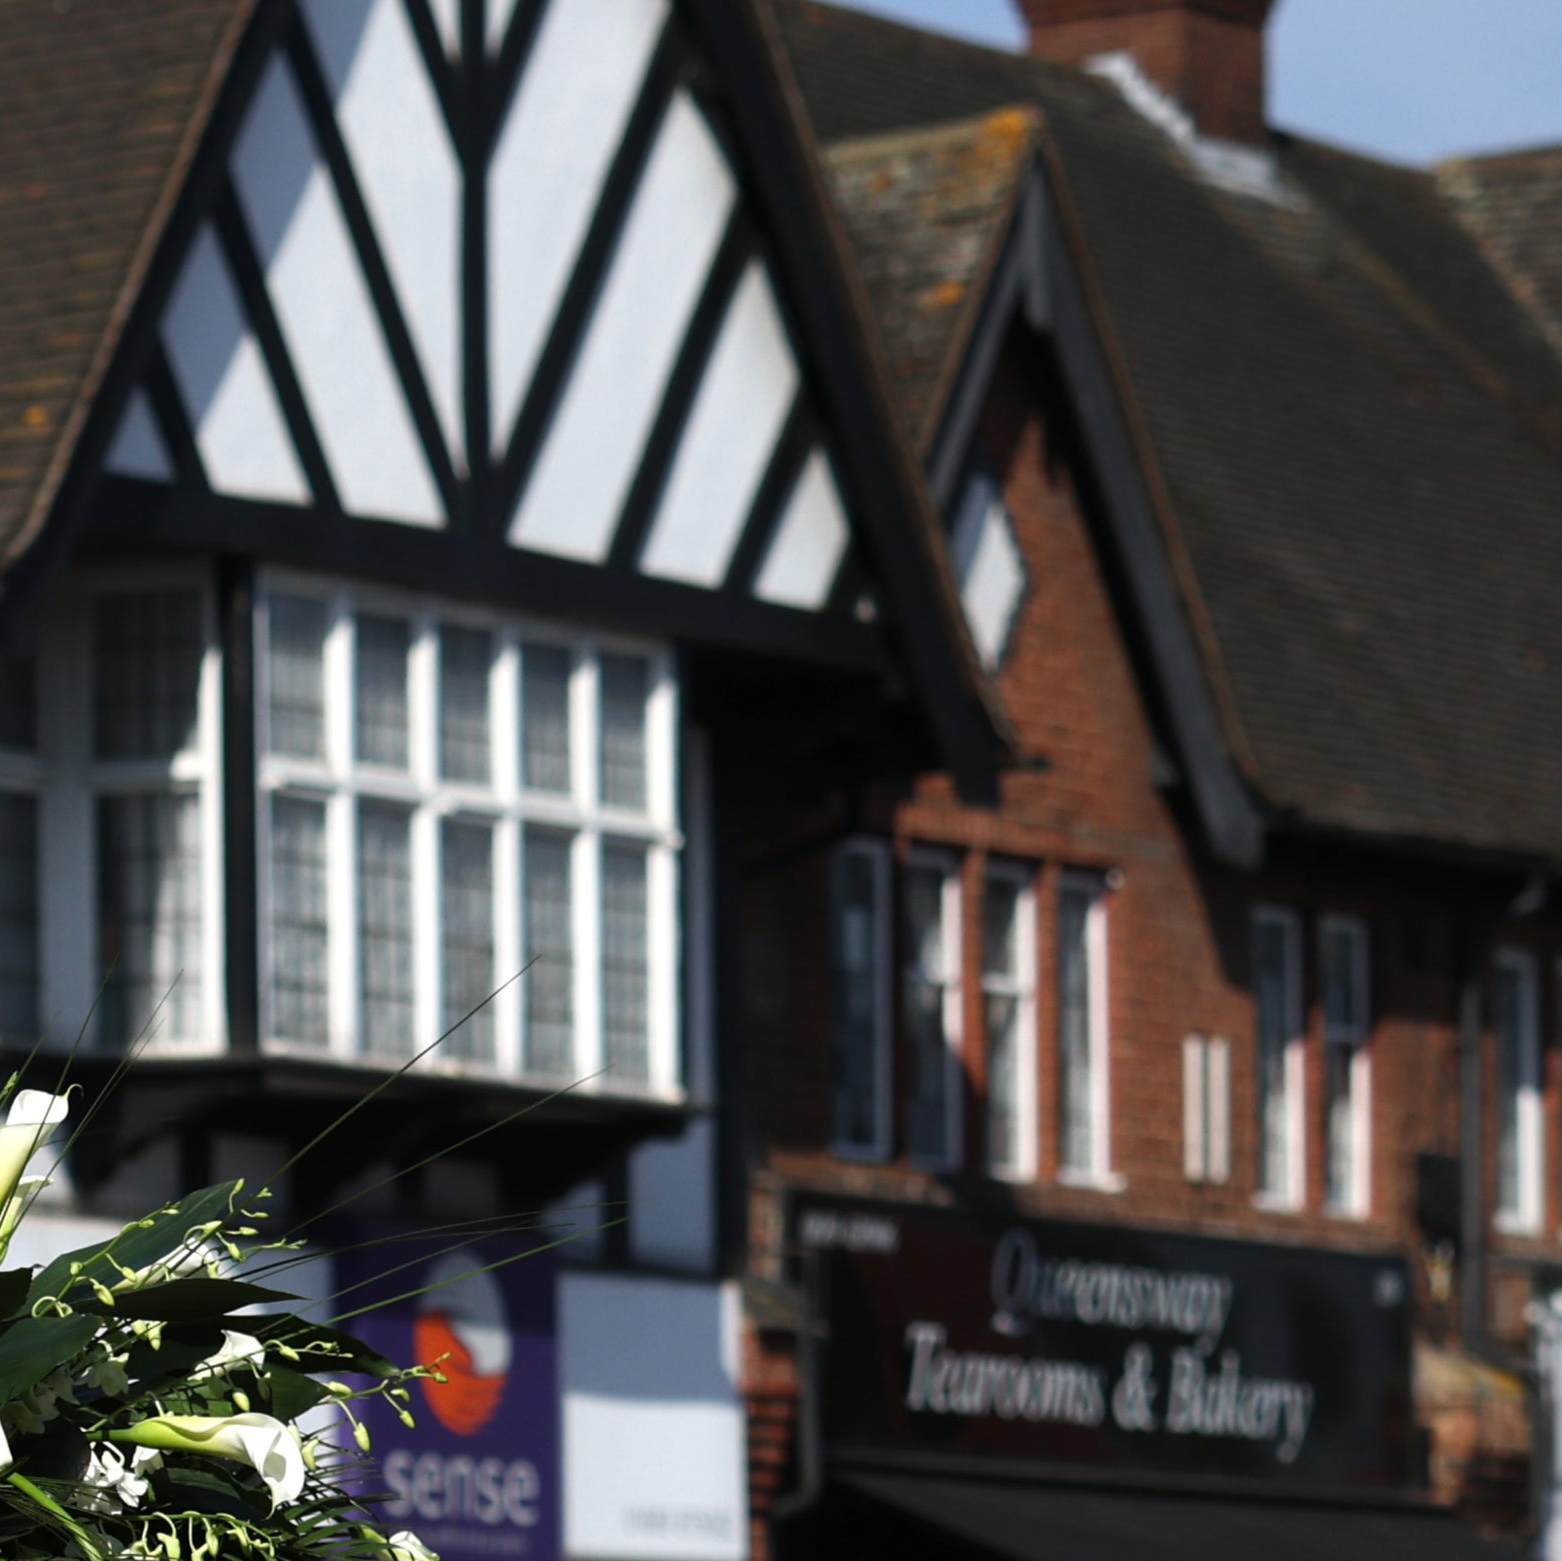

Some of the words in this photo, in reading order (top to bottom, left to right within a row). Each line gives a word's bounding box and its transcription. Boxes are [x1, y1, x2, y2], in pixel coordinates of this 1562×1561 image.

[905, 1320, 1106, 1426] Tearooms
[1111, 1341, 1159, 1432] &
[1165, 1345, 1314, 1464] Bakery
[382, 1448, 542, 1528] sense
